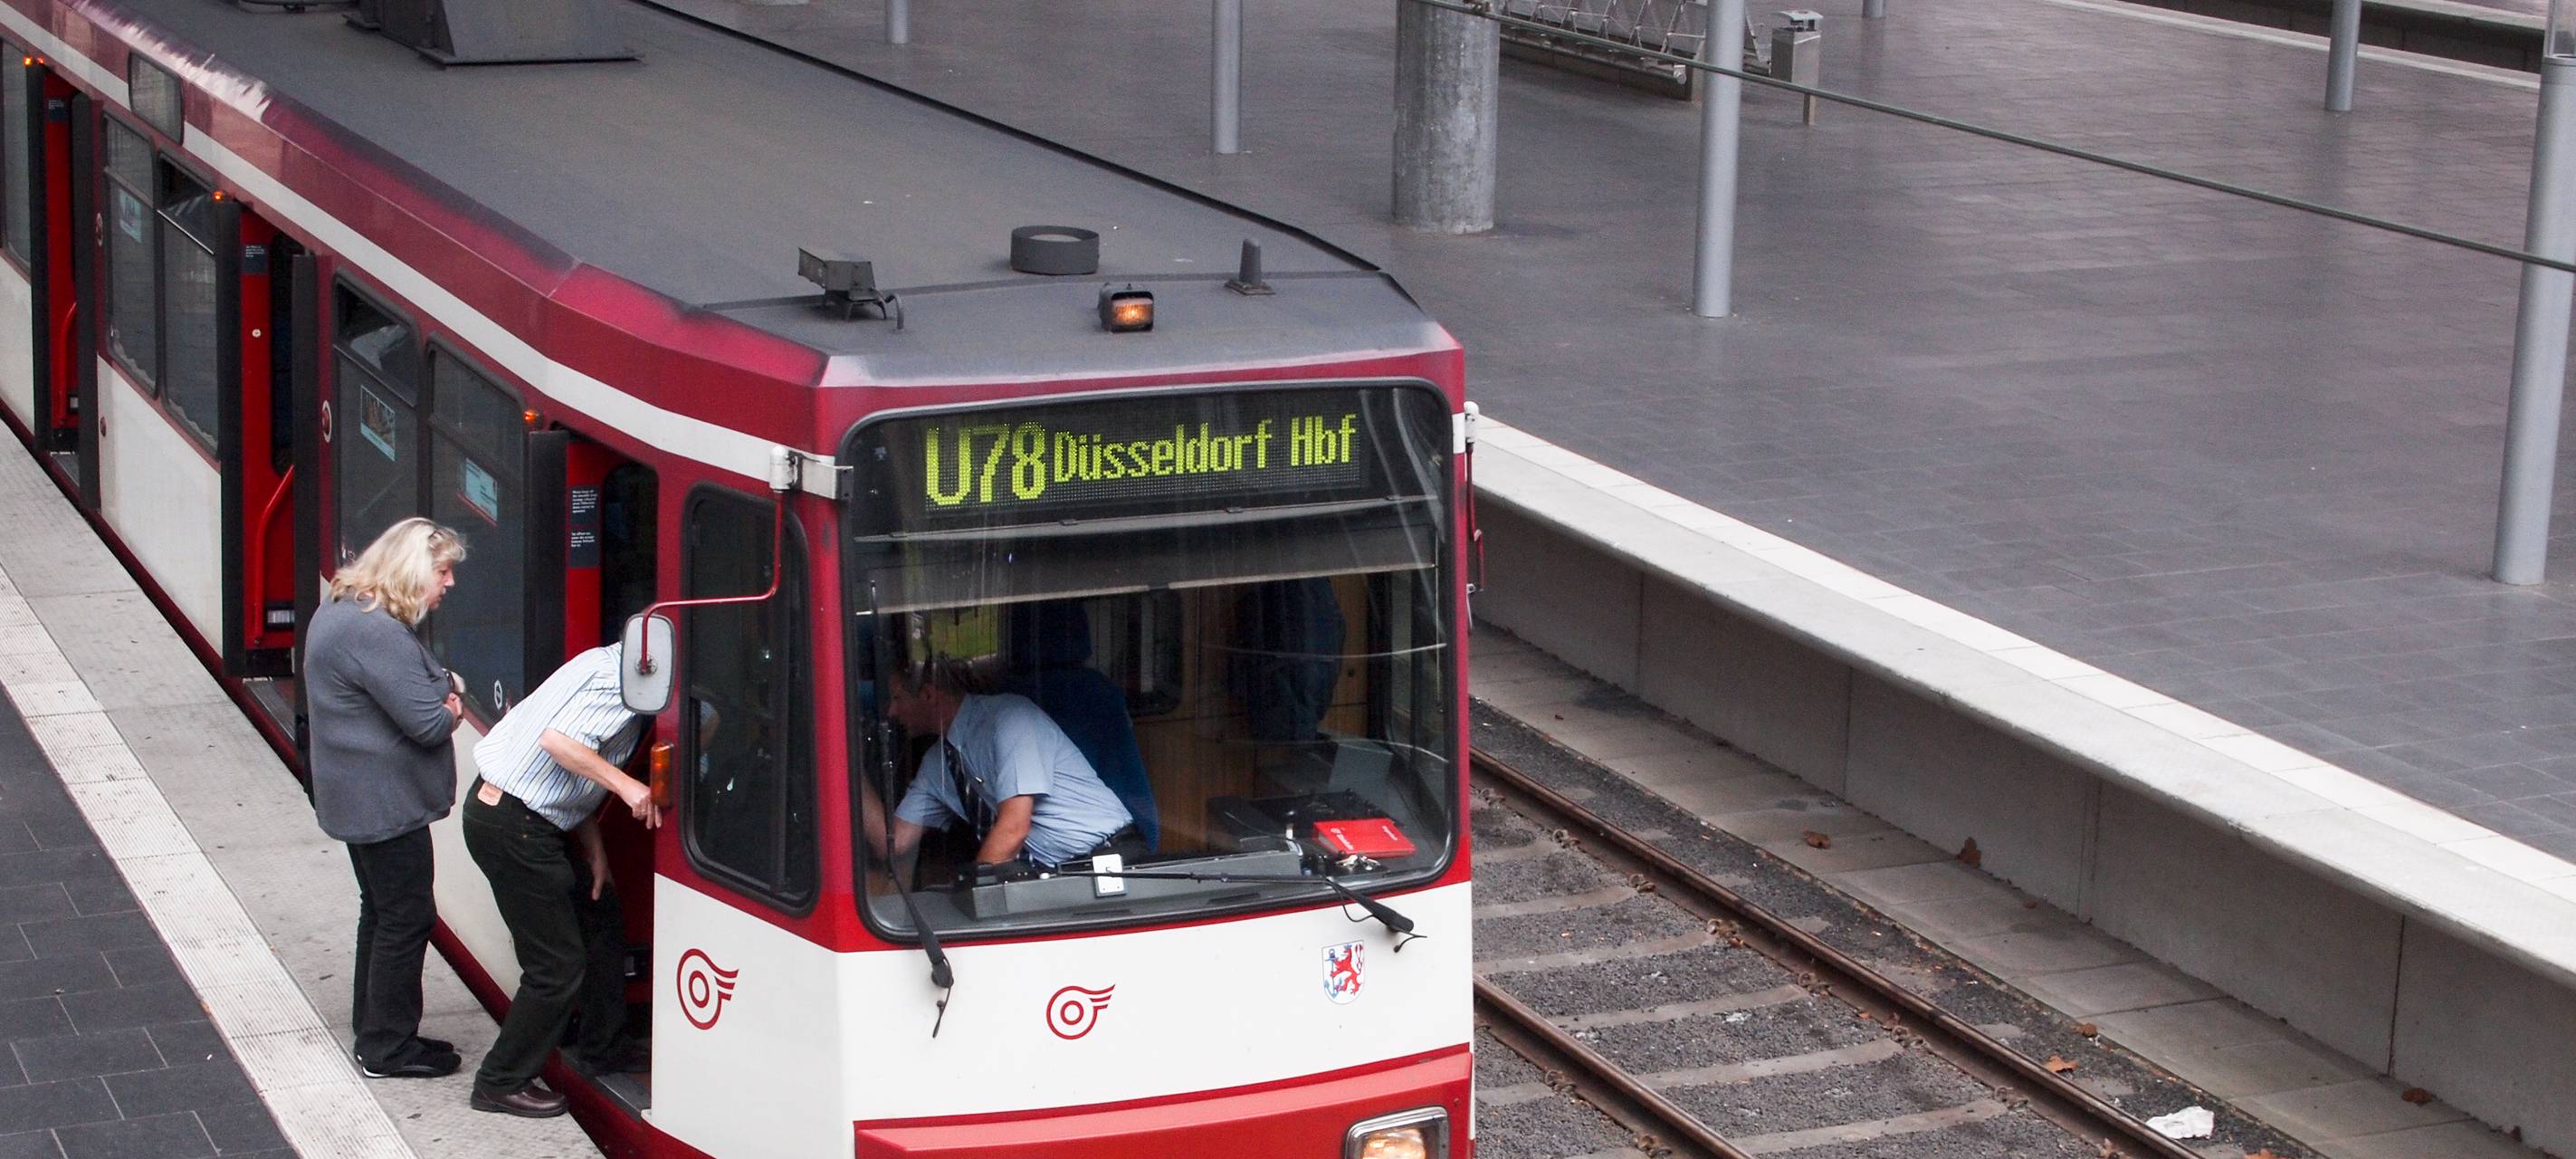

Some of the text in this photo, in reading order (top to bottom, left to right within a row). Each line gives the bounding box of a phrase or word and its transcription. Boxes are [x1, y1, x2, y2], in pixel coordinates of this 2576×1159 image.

[925, 414, 1357, 505] U78 Düsseldorf Hbf
